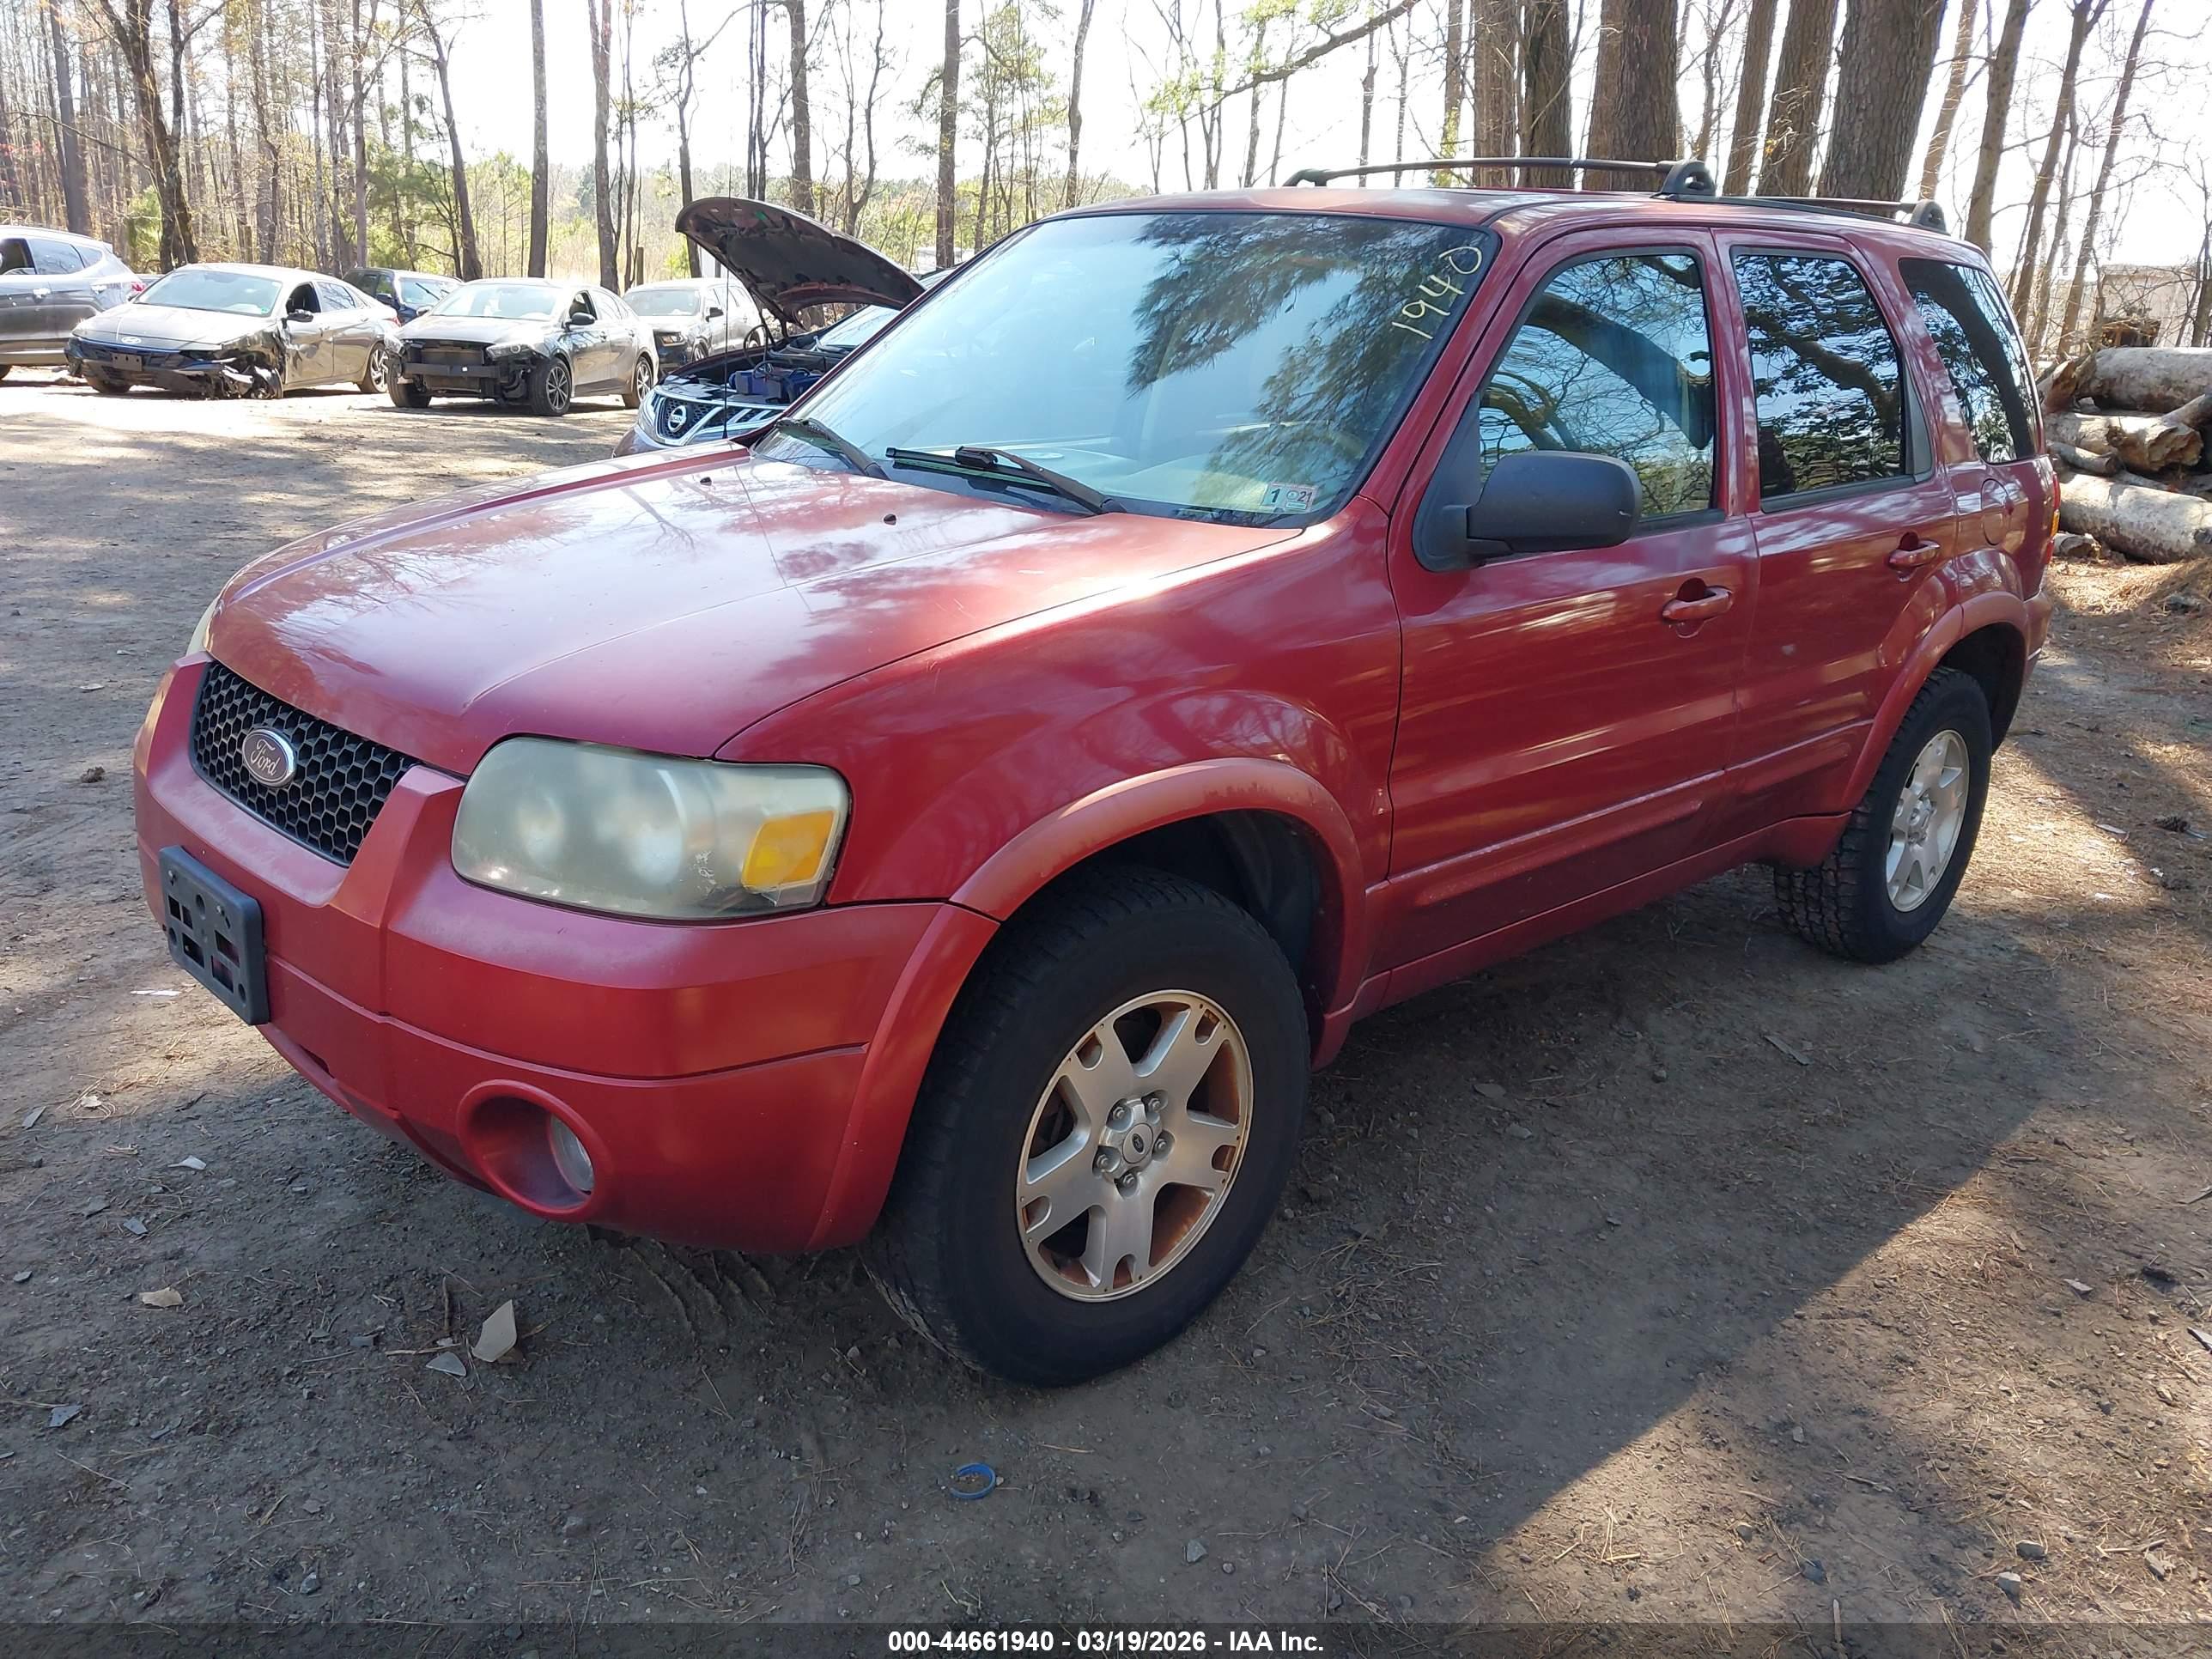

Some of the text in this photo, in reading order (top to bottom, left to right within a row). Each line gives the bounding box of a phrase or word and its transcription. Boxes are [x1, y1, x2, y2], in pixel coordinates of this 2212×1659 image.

[1391, 246, 1483, 340] 1940
[1271, 488, 1313, 503] 1 21
[250, 738, 281, 776] Ford
